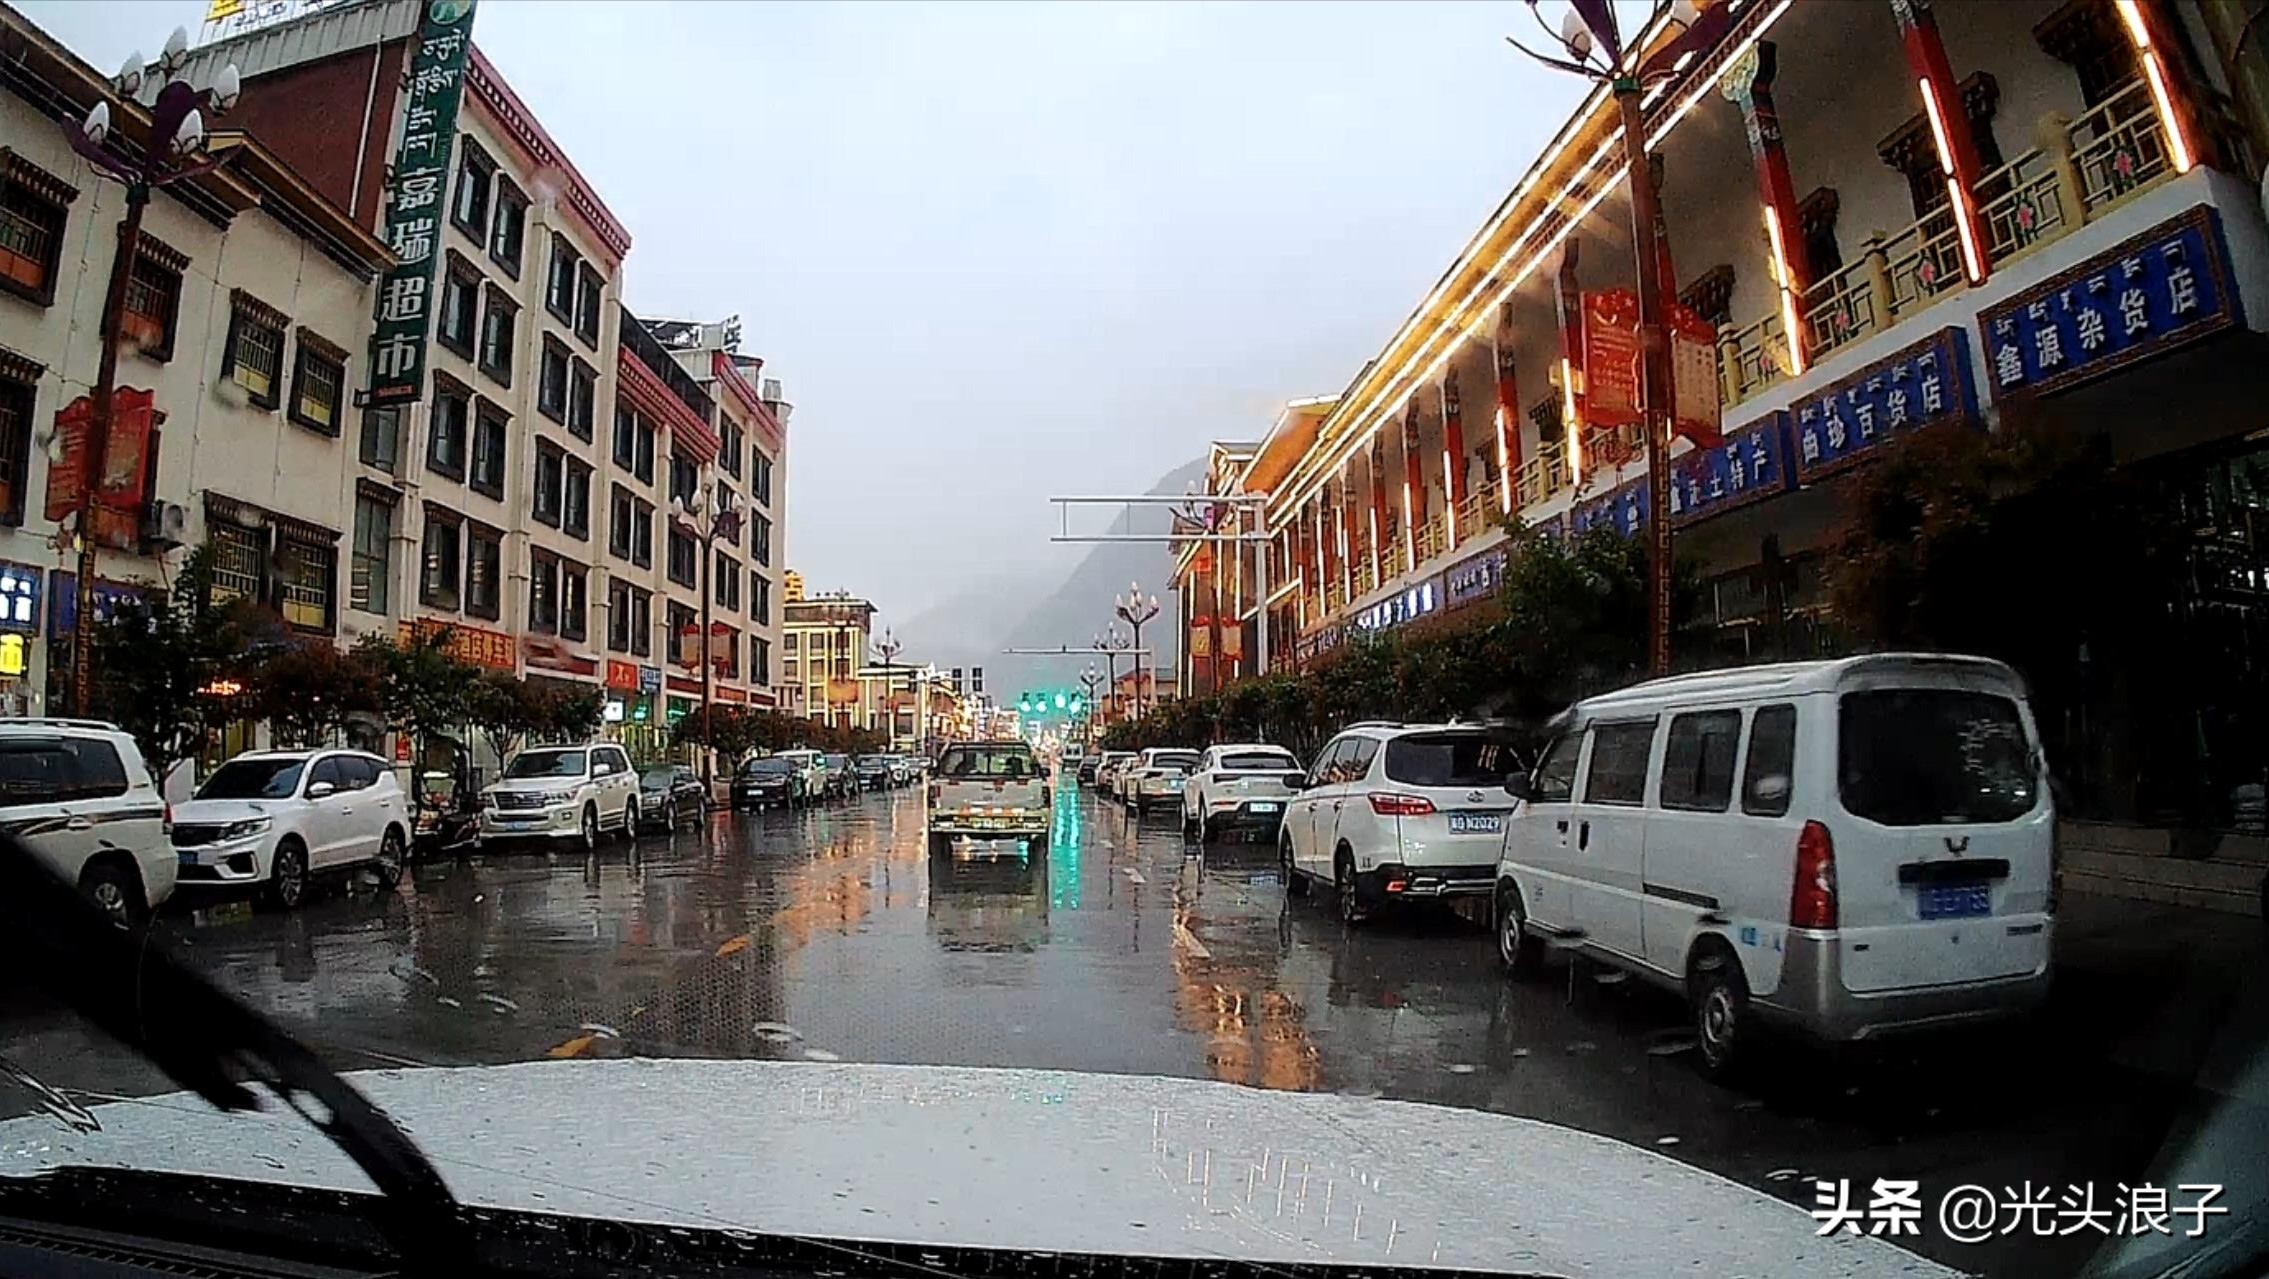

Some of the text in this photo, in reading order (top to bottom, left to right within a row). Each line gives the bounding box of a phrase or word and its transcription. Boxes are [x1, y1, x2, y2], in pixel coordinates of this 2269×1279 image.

[377, 167, 444, 379] 嘉瑞超市
[1995, 265, 2199, 386] 鑫源杂货店
